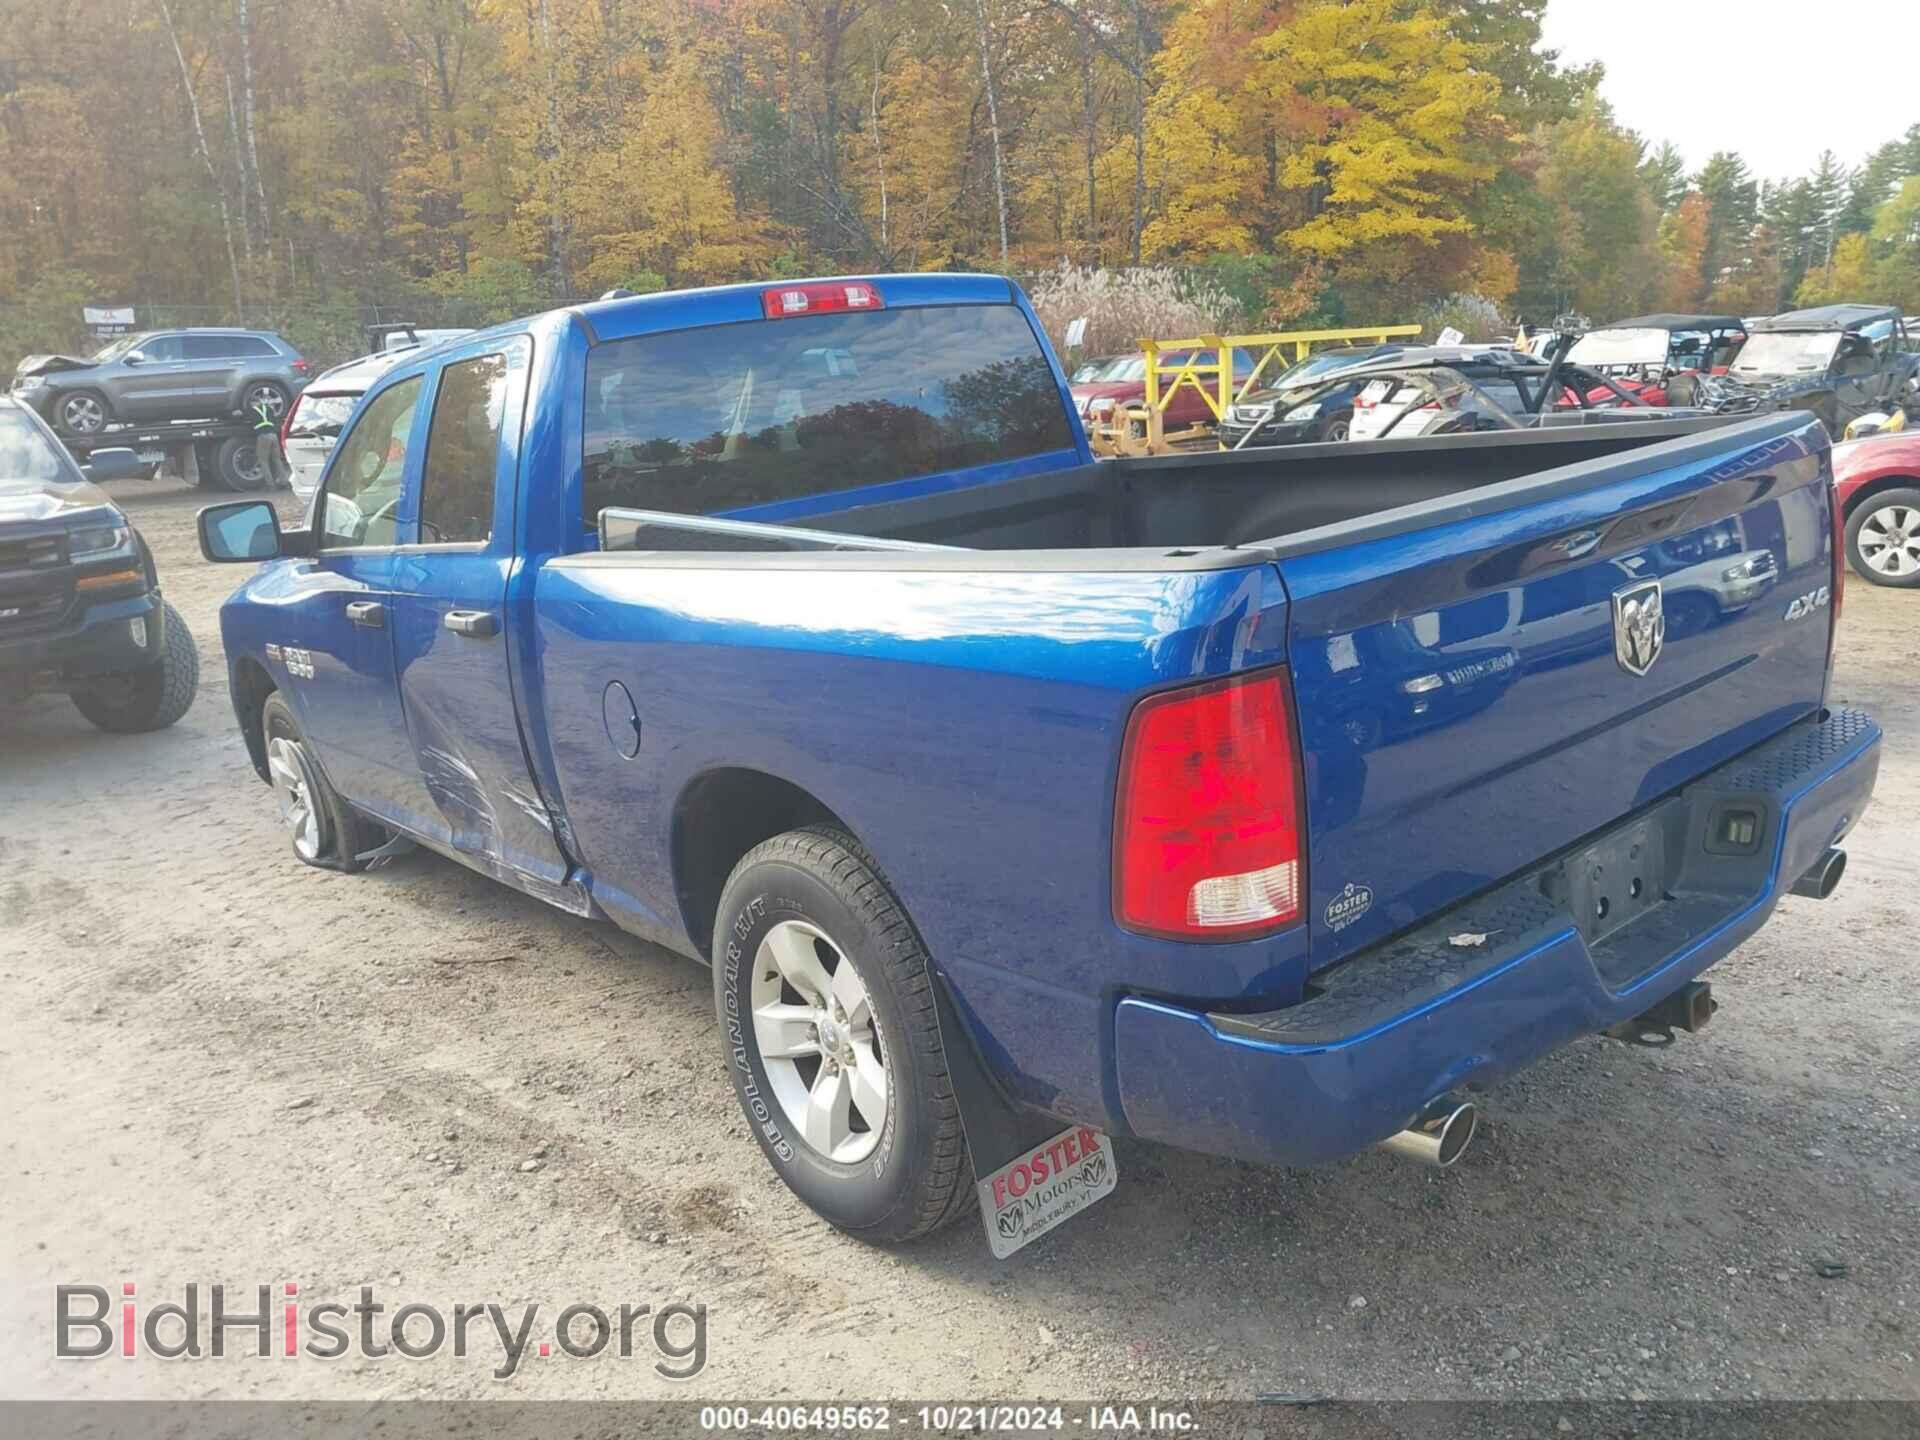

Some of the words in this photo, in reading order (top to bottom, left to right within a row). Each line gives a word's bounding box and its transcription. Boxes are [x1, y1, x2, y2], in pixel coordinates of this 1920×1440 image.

[1784, 586, 1830, 621] 4X4
[1328, 891, 1369, 918] FOSTER
[724, 941, 795, 1162] GEOLANDAR
[991, 1125, 1101, 1210] FOSTER
[1024, 1174, 1084, 1215] Motors
